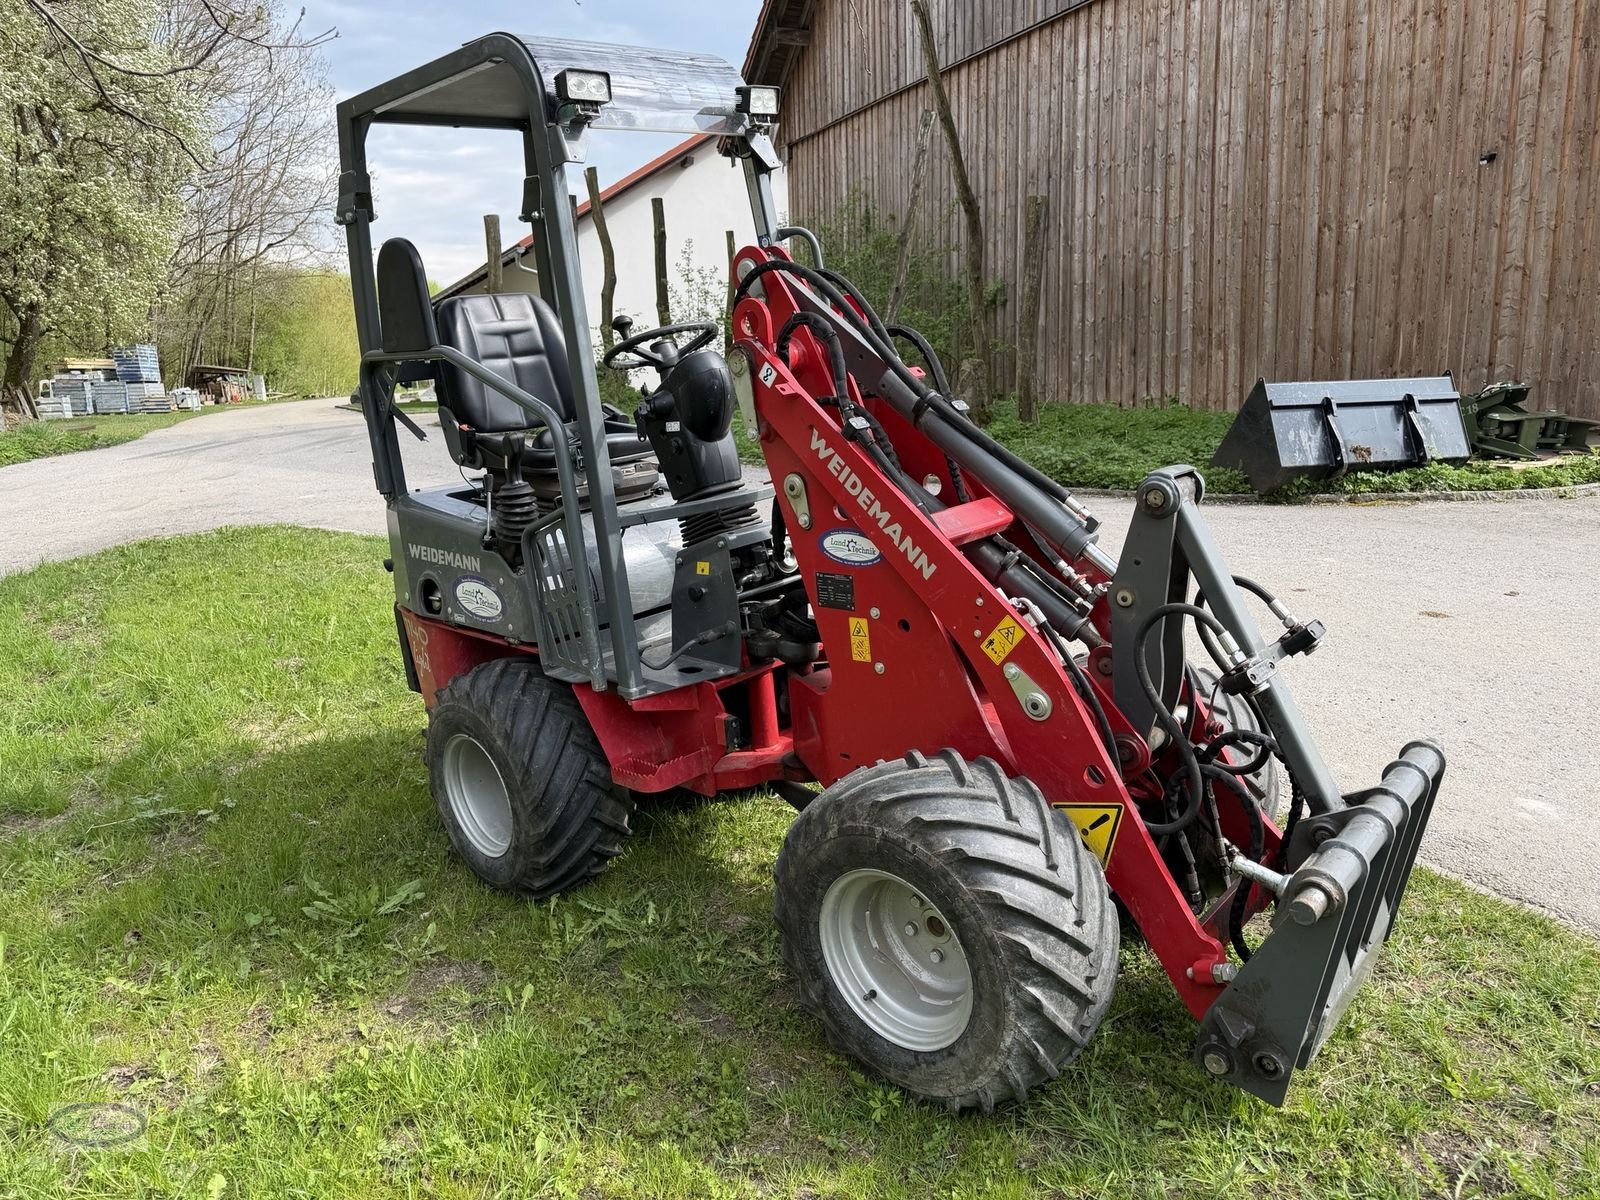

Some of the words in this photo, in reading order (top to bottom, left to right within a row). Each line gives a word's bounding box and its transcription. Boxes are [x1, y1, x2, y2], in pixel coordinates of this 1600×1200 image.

[810, 426, 938, 581] WEIDEMANN
[408, 543, 481, 573] WEIDEMANN
[830, 537, 847, 547] Land
[851, 545, 877, 556] Technik
